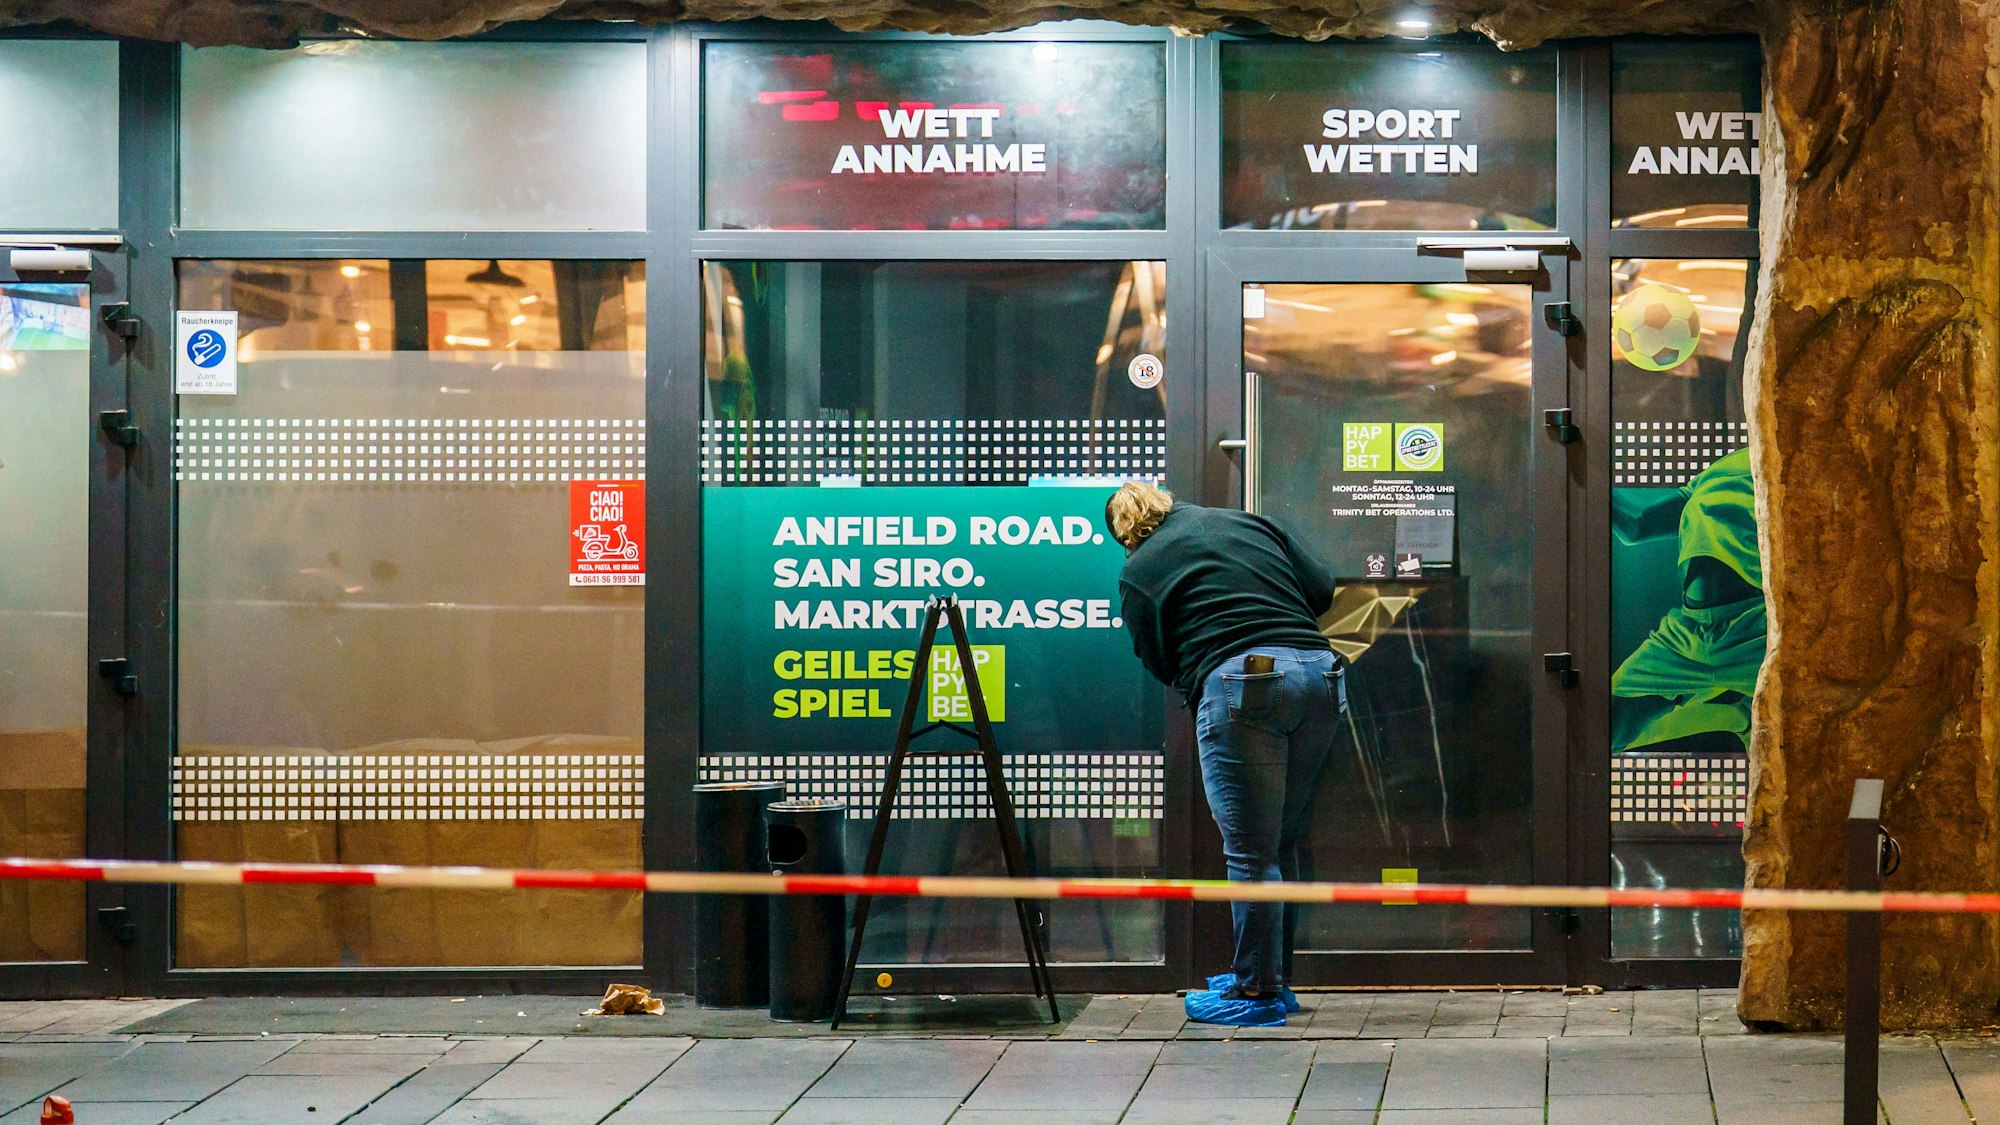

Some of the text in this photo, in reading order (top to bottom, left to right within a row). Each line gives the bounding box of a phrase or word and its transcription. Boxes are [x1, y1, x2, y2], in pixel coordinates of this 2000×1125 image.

[878, 108, 1000, 139] WETT
[1322, 109, 1461, 139] SPORT
[1675, 111, 1762, 140] WET
[831, 143, 1046, 174] ANNAHME
[1303, 144, 1478, 174] WETTEN
[181, 317, 234, 326] Raucherkneipe
[1346, 425, 1383, 440] HAP
[1346, 440, 1369, 454] PY
[1346, 454, 1380, 469] BET
[590, 490, 624, 506] CIAO!
[1352, 493, 1435, 502] SONNTAG, 12-24 UHR
[1414, 485, 1436, 493] 10-24
[1437, 485, 1455, 493] UHR
[590, 506, 624, 521] CIAO!
[1332, 508, 1455, 516] TRINITY BET OPERATIONS LTD.
[773, 516, 1104, 546] ANFIELD ROAD.
[578, 563, 640, 571] PIZZA, PASTA, NO DRAMA
[773, 557, 986, 588] SAN SIRO.
[612, 575, 626, 583] 999
[628, 575, 640, 583] 581
[773, 650, 917, 680] GEILES
[932, 672, 966, 694] PY
[773, 688, 892, 719] SPIEL
[932, 695, 987, 717] BE
